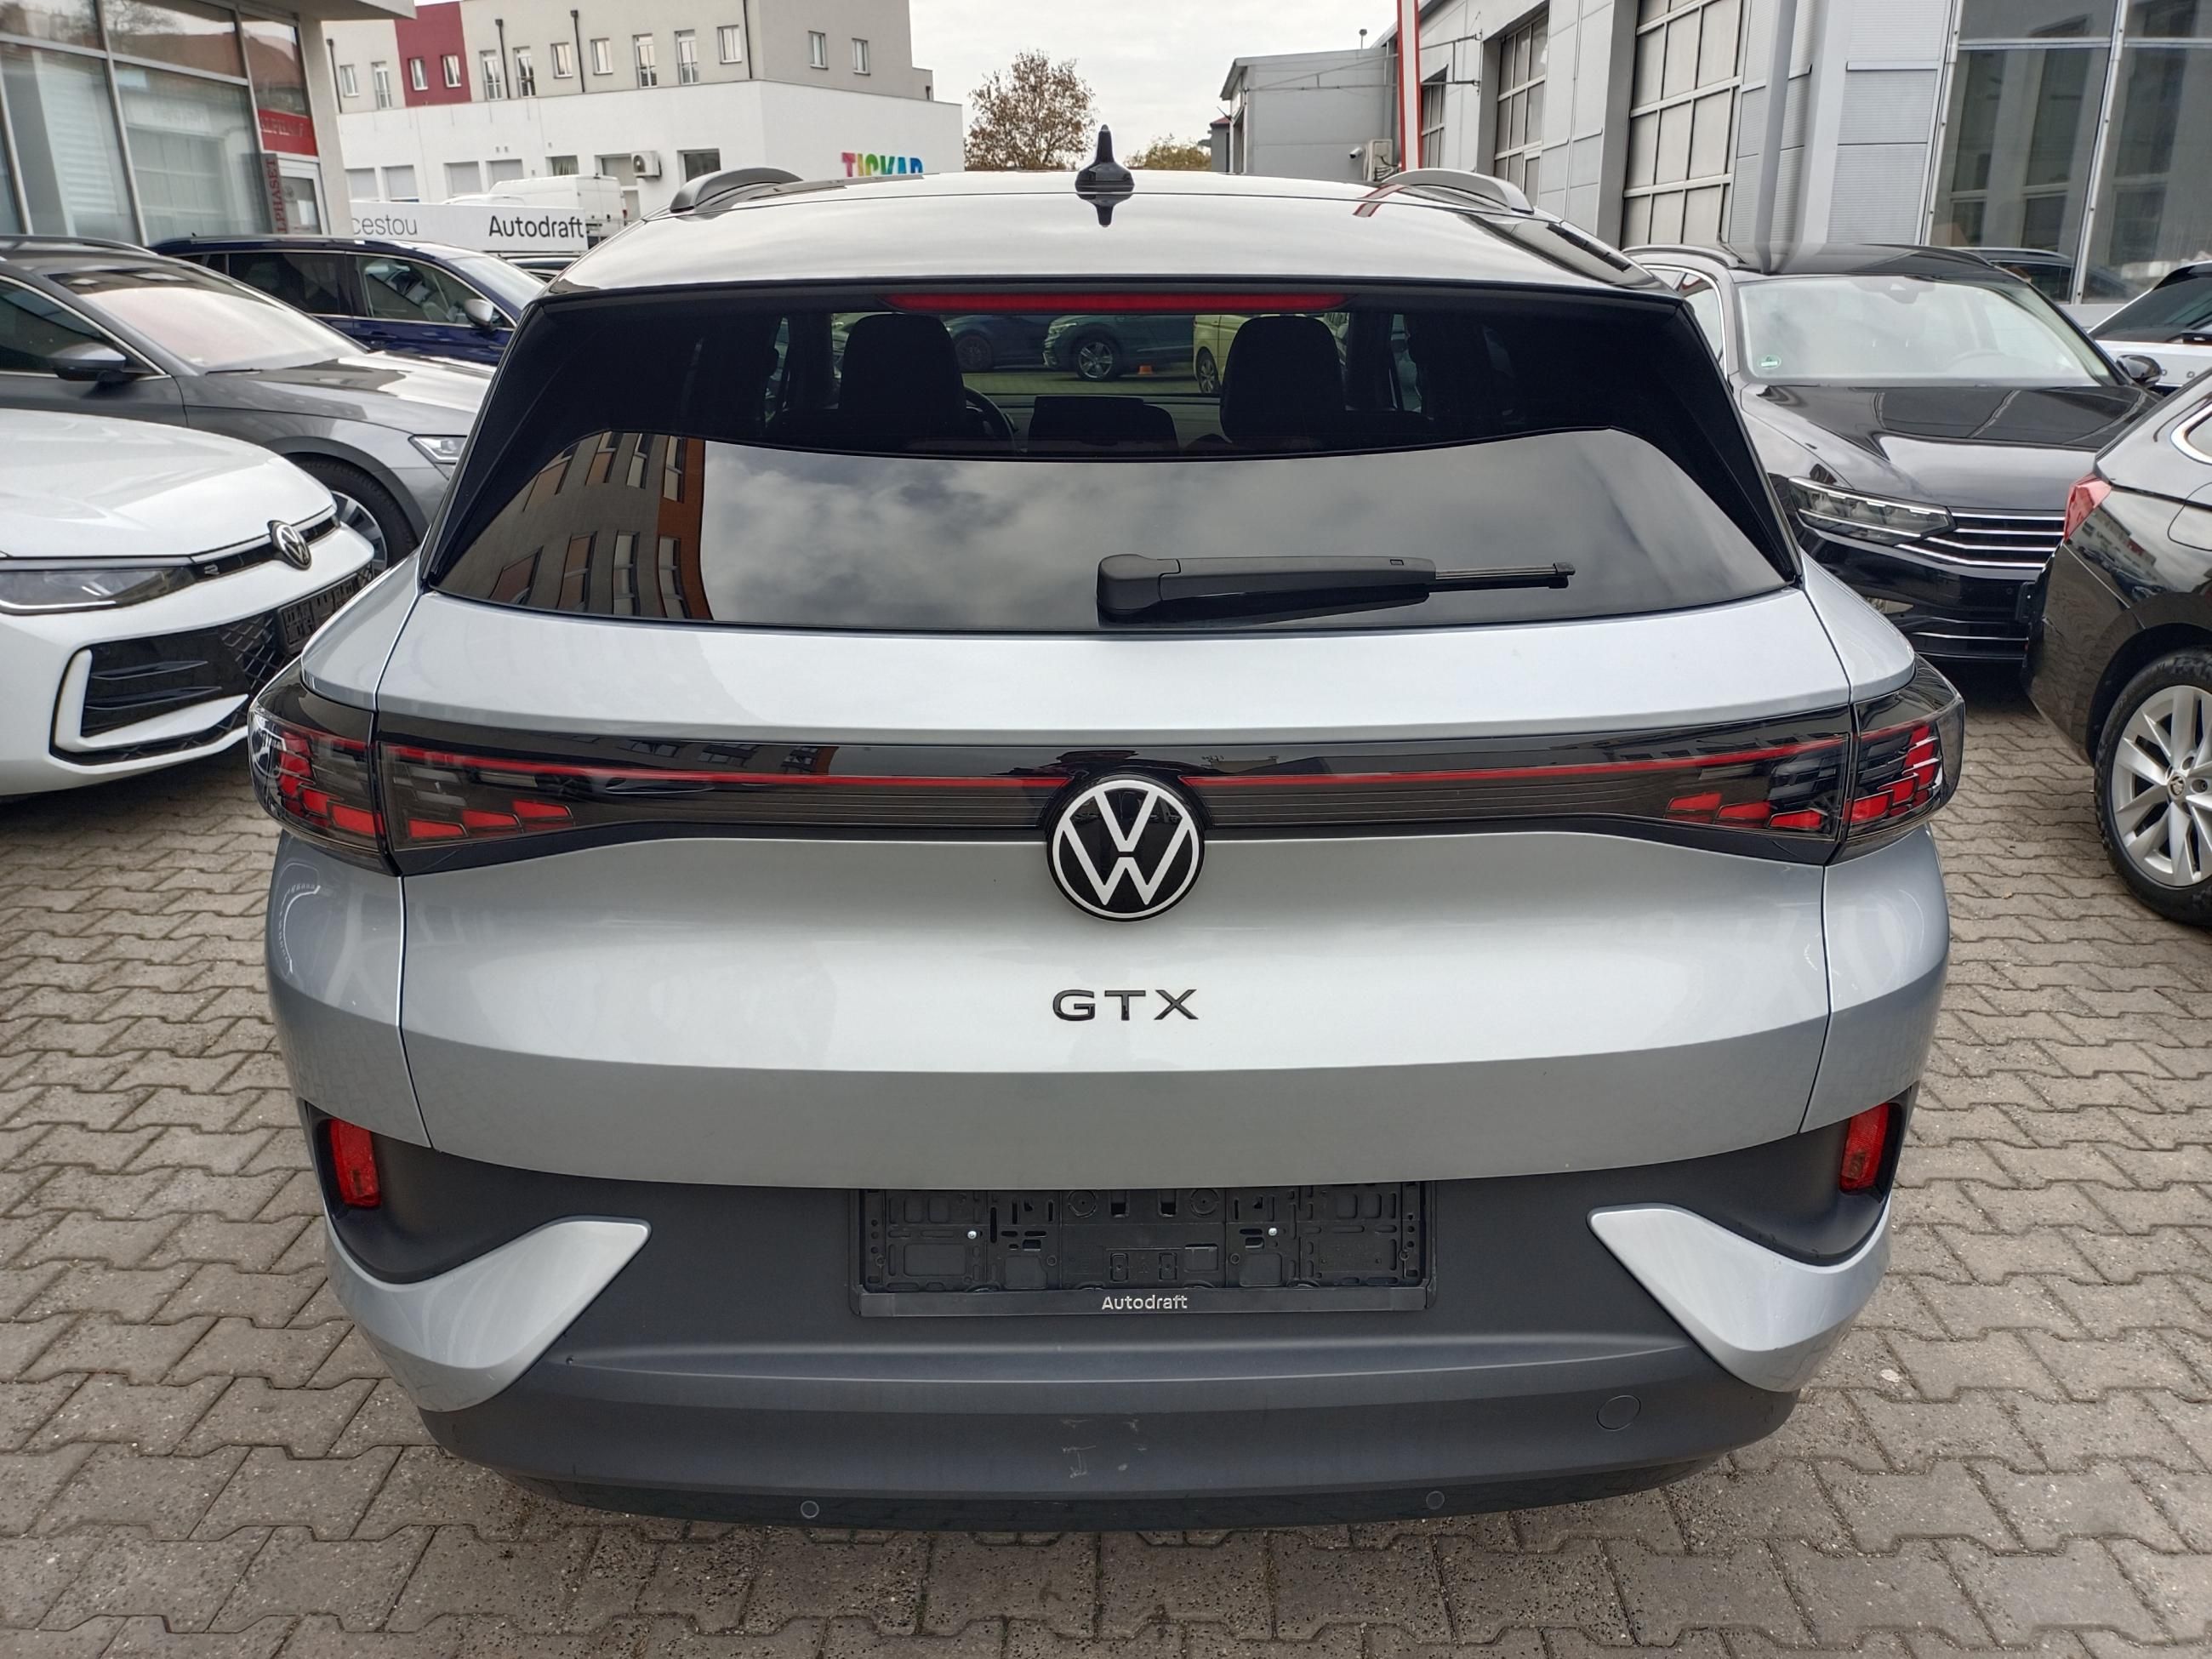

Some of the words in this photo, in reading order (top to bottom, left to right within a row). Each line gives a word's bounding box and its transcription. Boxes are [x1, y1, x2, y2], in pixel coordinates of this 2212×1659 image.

[265, 158, 288, 233] LPHASET
[488, 215, 584, 238] Autodraft
[1052, 989, 1199, 1022] GTX
[1101, 1294, 1188, 1310] Autodraft
